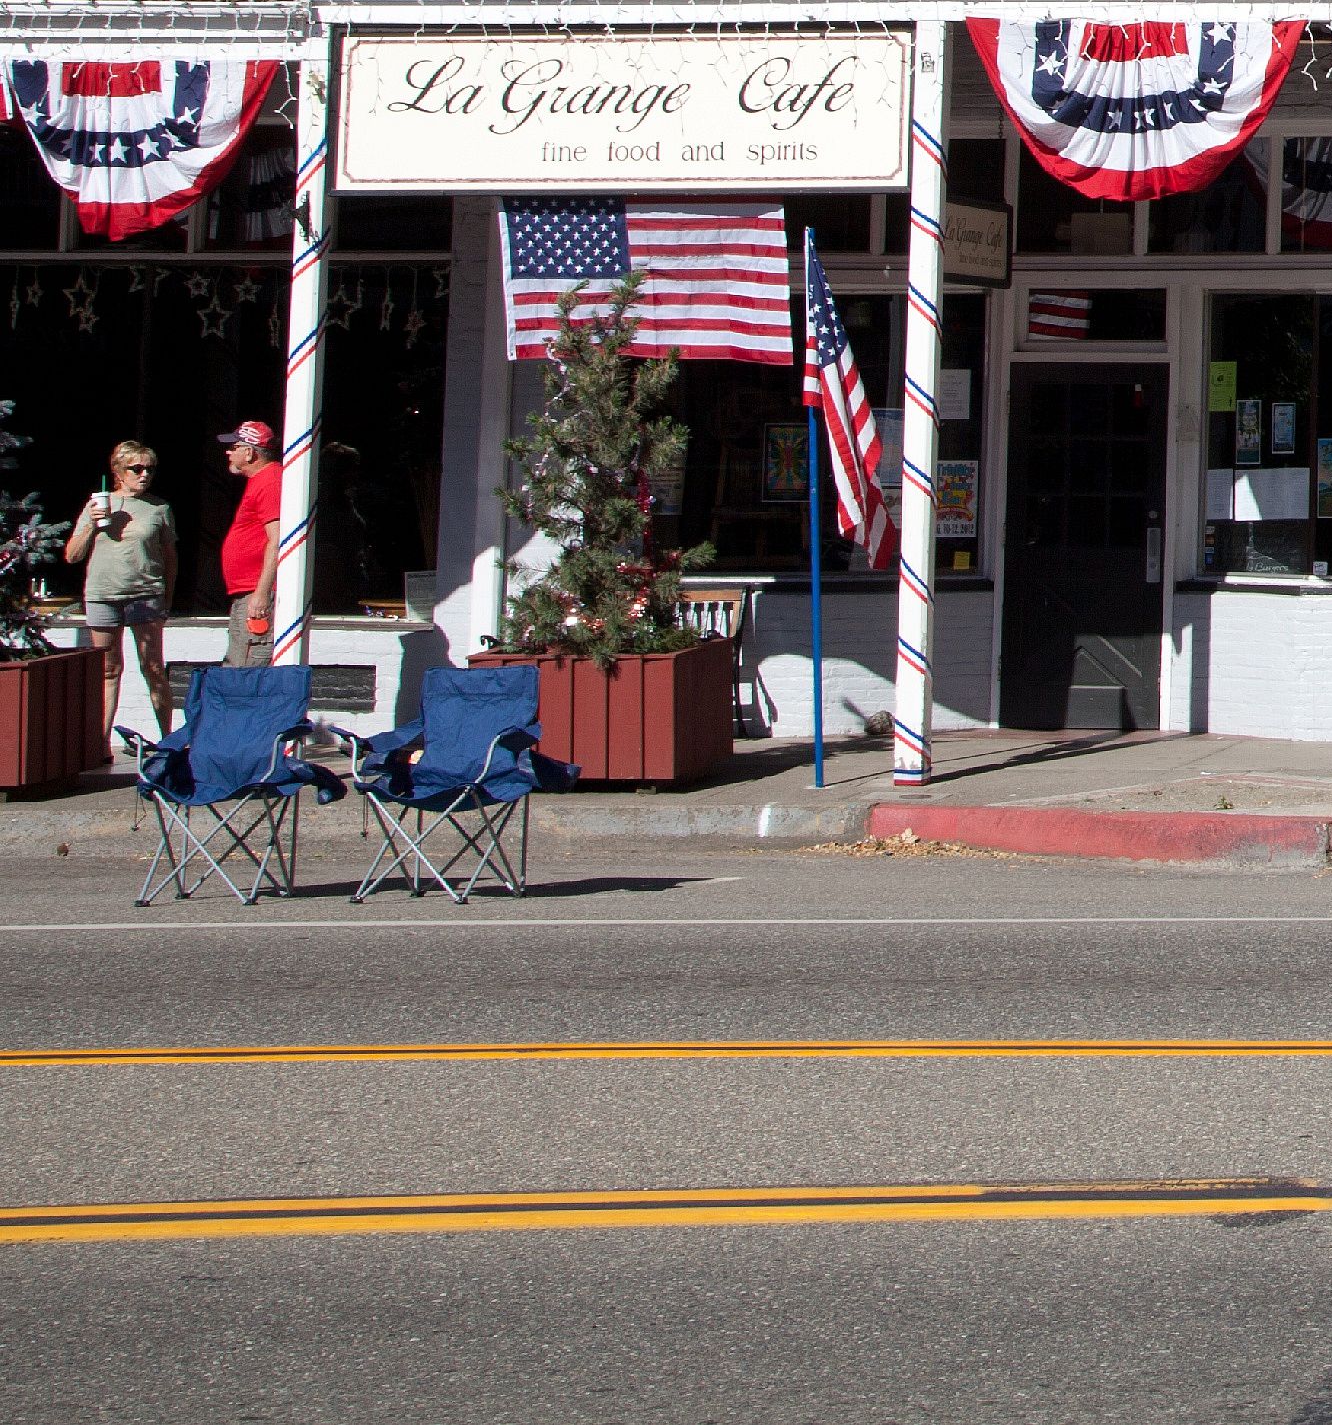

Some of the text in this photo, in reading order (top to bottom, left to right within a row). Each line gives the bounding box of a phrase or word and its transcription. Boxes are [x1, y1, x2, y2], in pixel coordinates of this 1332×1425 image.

[387, 56, 860, 135] La Grange Cafe
[541, 140, 818, 166] fine food and spirits
